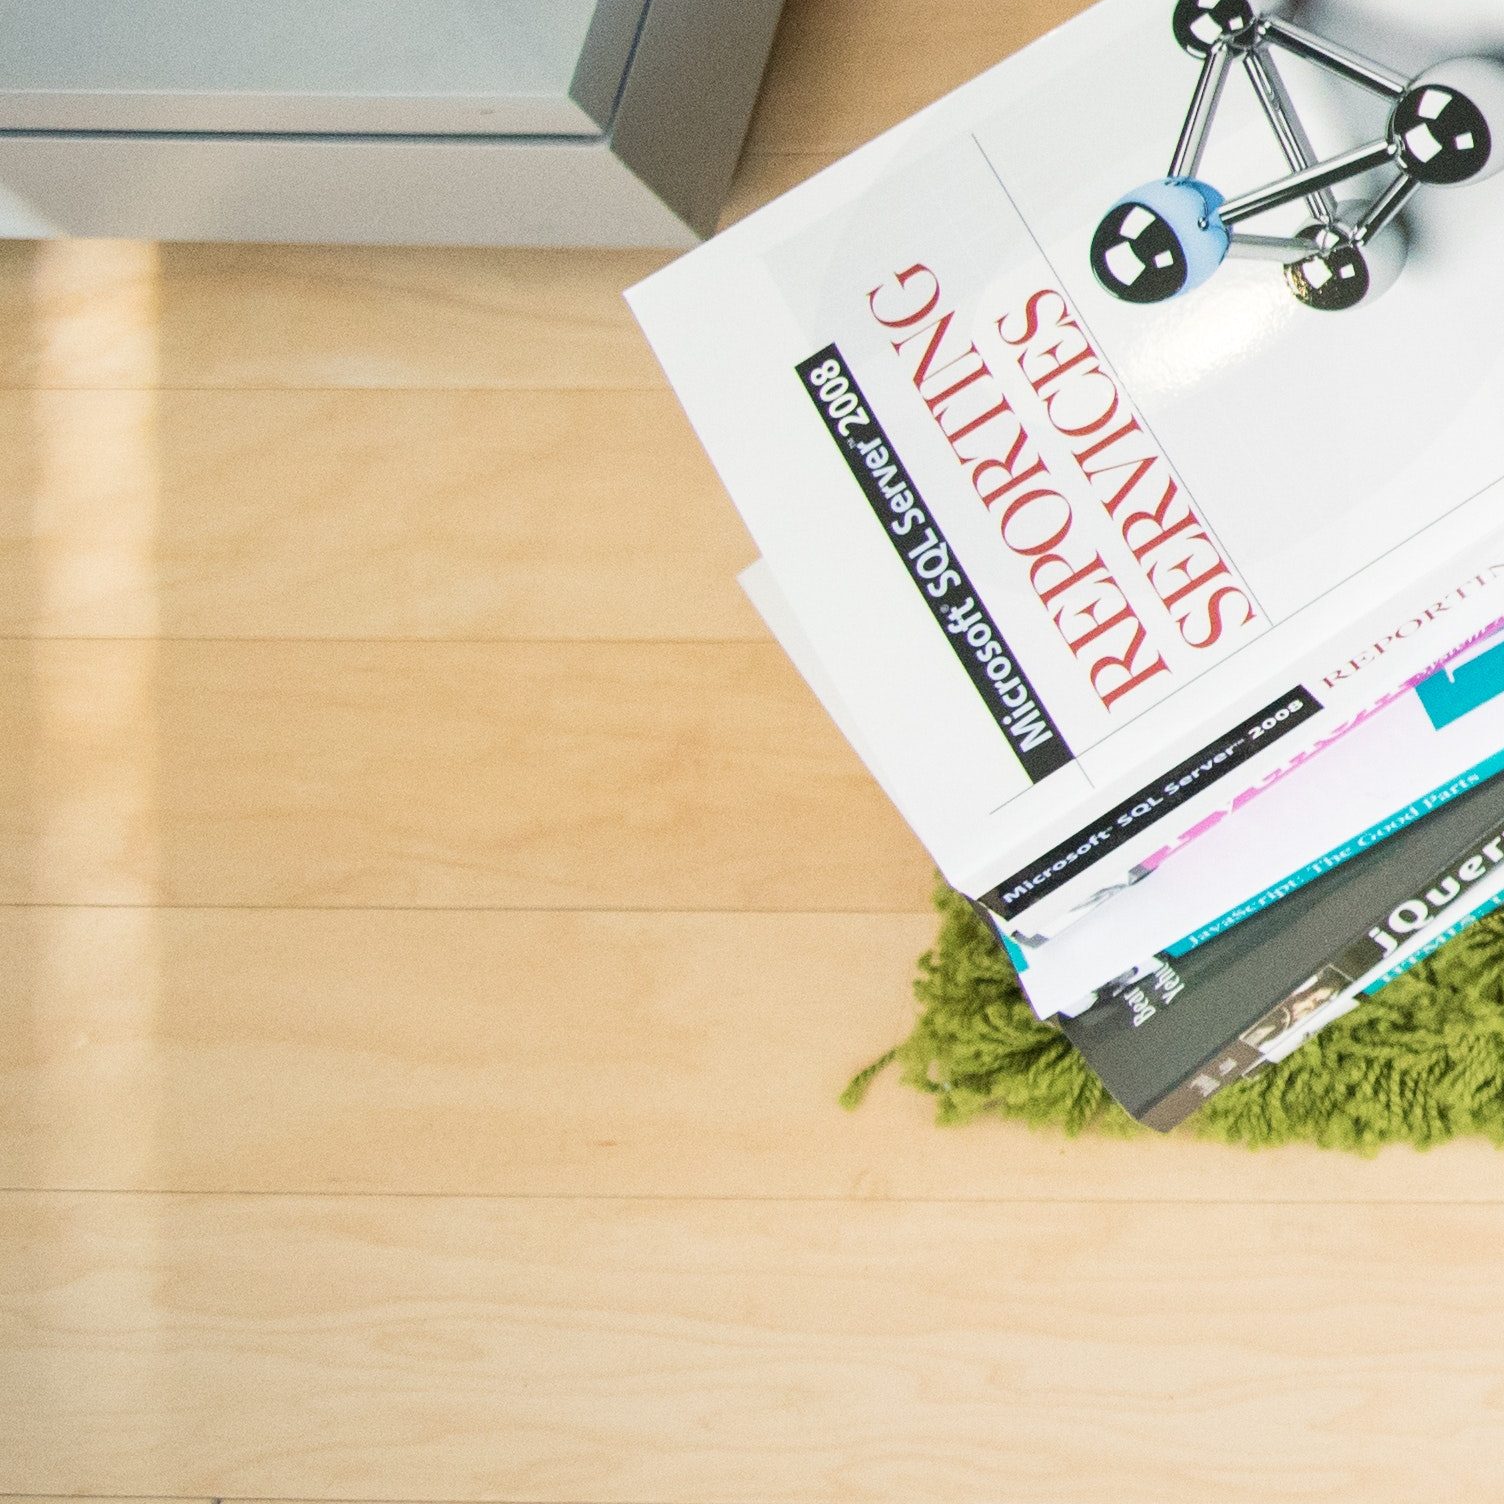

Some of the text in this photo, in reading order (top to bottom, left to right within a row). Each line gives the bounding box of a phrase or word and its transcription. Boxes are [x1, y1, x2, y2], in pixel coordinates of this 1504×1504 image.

[808, 357, 1053, 752] Microsoft SQL Server 2008
[856, 262, 1173, 714] REPORTING
[997, 287, 1257, 651] SERVICES
[1001, 698, 1304, 904] Microsoft SQL Server 2008
[1182, 766, 1480, 955] JavaScript: The Good Parts
[1122, 986, 1157, 1028] Bear
